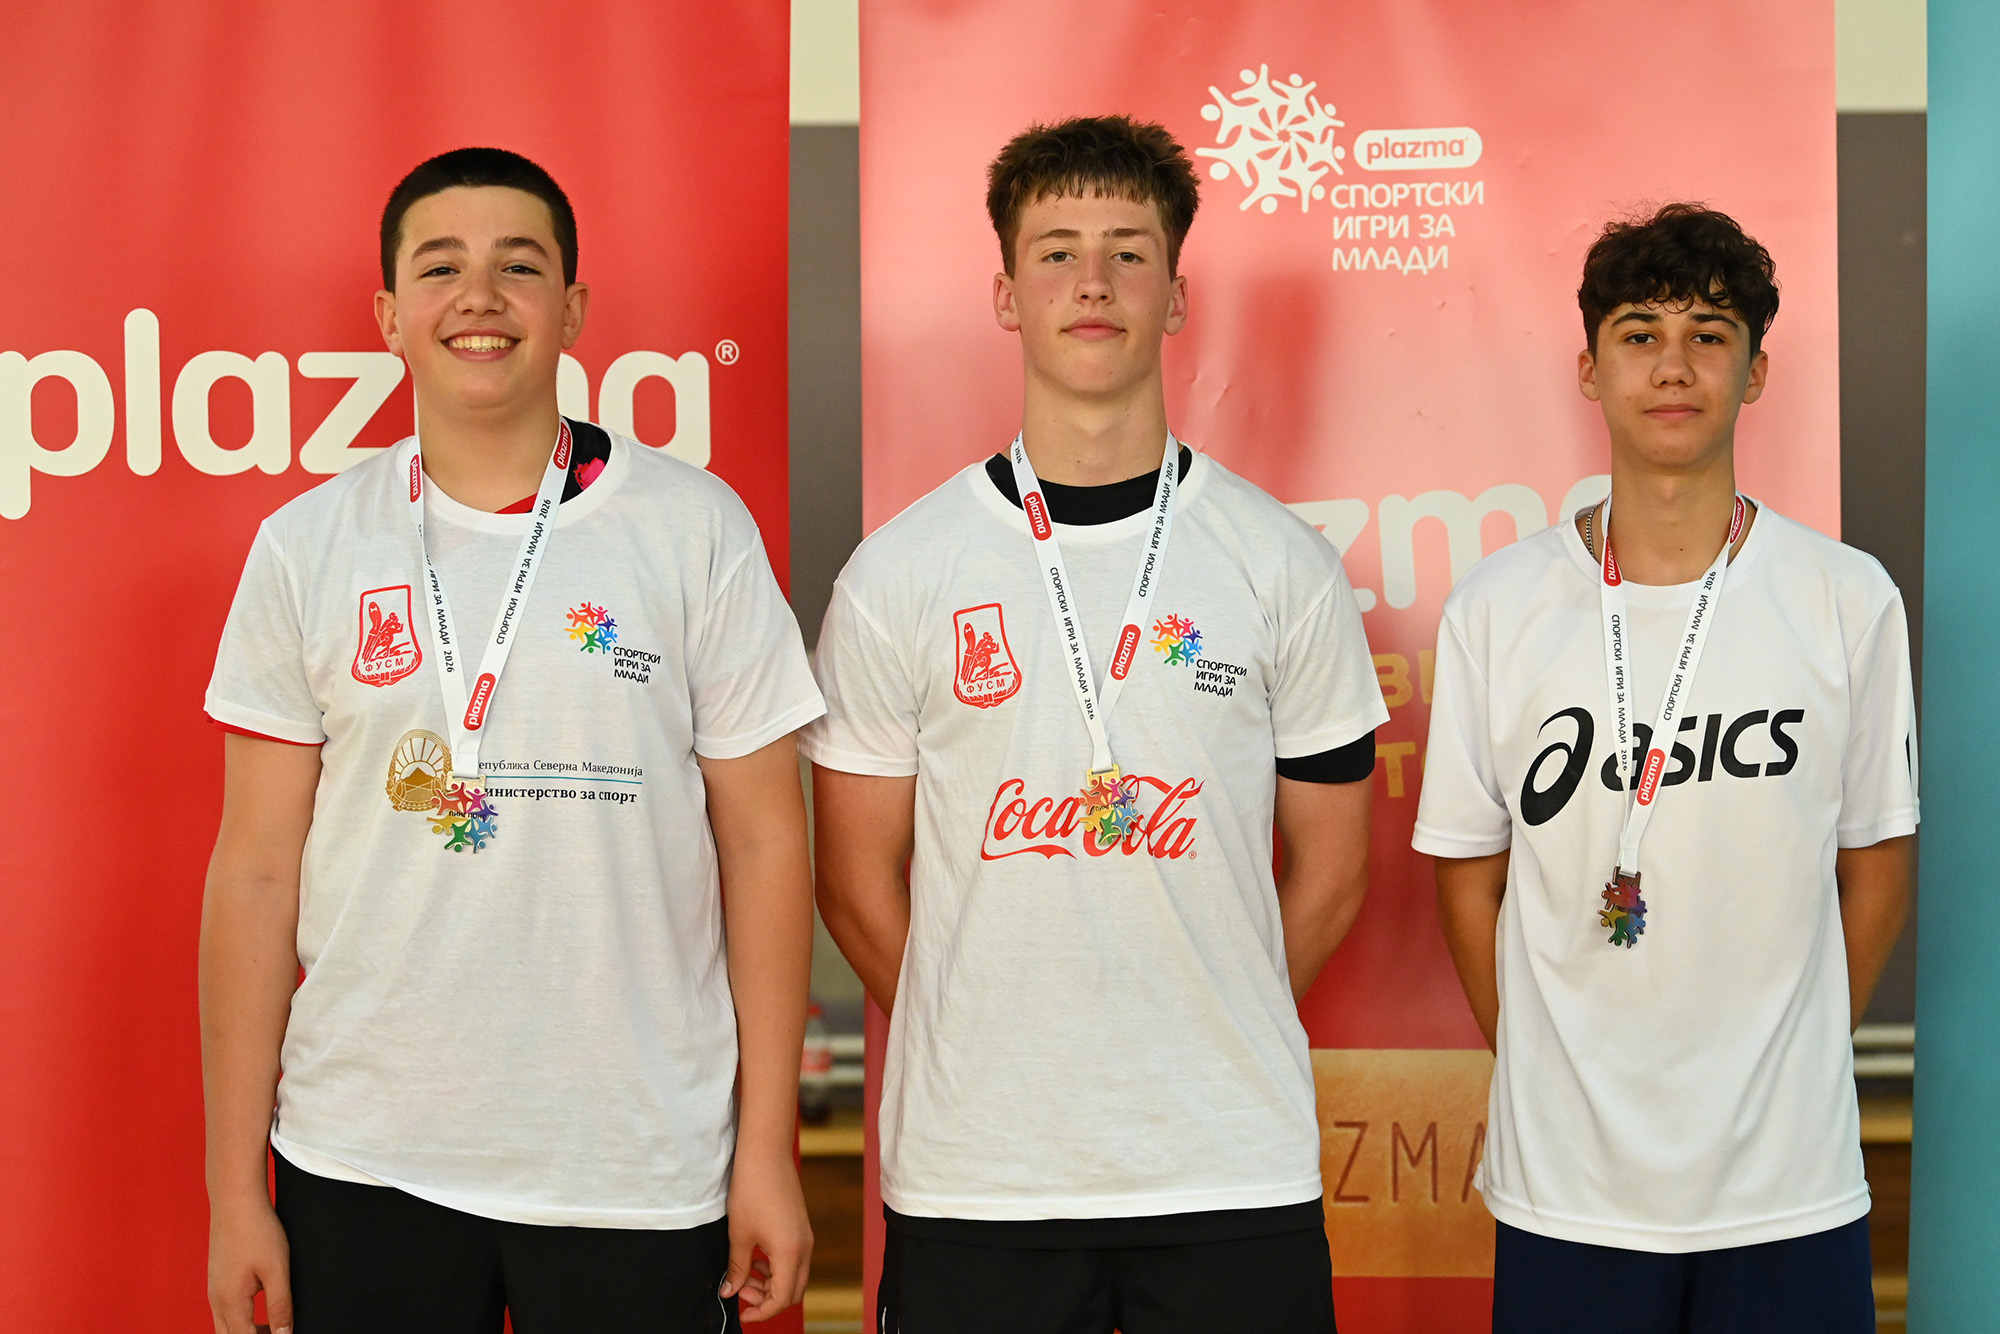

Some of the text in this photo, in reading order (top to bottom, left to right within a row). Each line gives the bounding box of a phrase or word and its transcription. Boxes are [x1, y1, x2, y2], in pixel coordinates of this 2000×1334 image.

[1366, 137, 1465, 164] plazma
[1330, 181, 1484, 209] СПОРТСКИ
[1333, 213, 1456, 240] ИГРИ ЗА
[1332, 245, 1448, 275] МЛАДИ
[556, 428, 569, 467] plazma
[1025, 496, 1047, 534] plazma
[1138, 462, 1174, 598] СПОРТСКИ ИГРИ ЗА МЛАДИ 2026
[496, 499, 551, 645] СПОРТСКИ ИГРИ ЗА МЛАДИ 2026
[437, 608, 451, 645] МЛАДИ
[613, 646, 661, 664] СПОРТСКИ
[1050, 567, 1095, 720] СПОРТСКИ ИГРИ ЗА МЛАДИ 2026
[1114, 631, 1136, 677] plazma
[1663, 571, 1716, 721] СПОРТСКИ ИГРИ ЗА МЛАДИ 2026
[365, 657, 404, 672] ФУСМ
[443, 650, 455, 673] 2026
[614, 658, 651, 673] ИГРИ ЗА
[1196, 659, 1248, 677] СПОРТСКИ
[614, 669, 649, 684] МЛАДИ
[965, 678, 1006, 693] ФУСМ
[1193, 682, 1233, 698] МЛАДИ
[1195, 671, 1237, 686] ИГРИ ЗА
[468, 680, 491, 726] plazma
[1611, 614, 1628, 771] СПОРТСКИ ИГРИ ЗА МЛАДИ 2026
[478, 760, 643, 776] епублика Северна Македонија
[1640, 756, 1660, 801] plazma
[484, 787, 637, 804] инистерство за спорт
